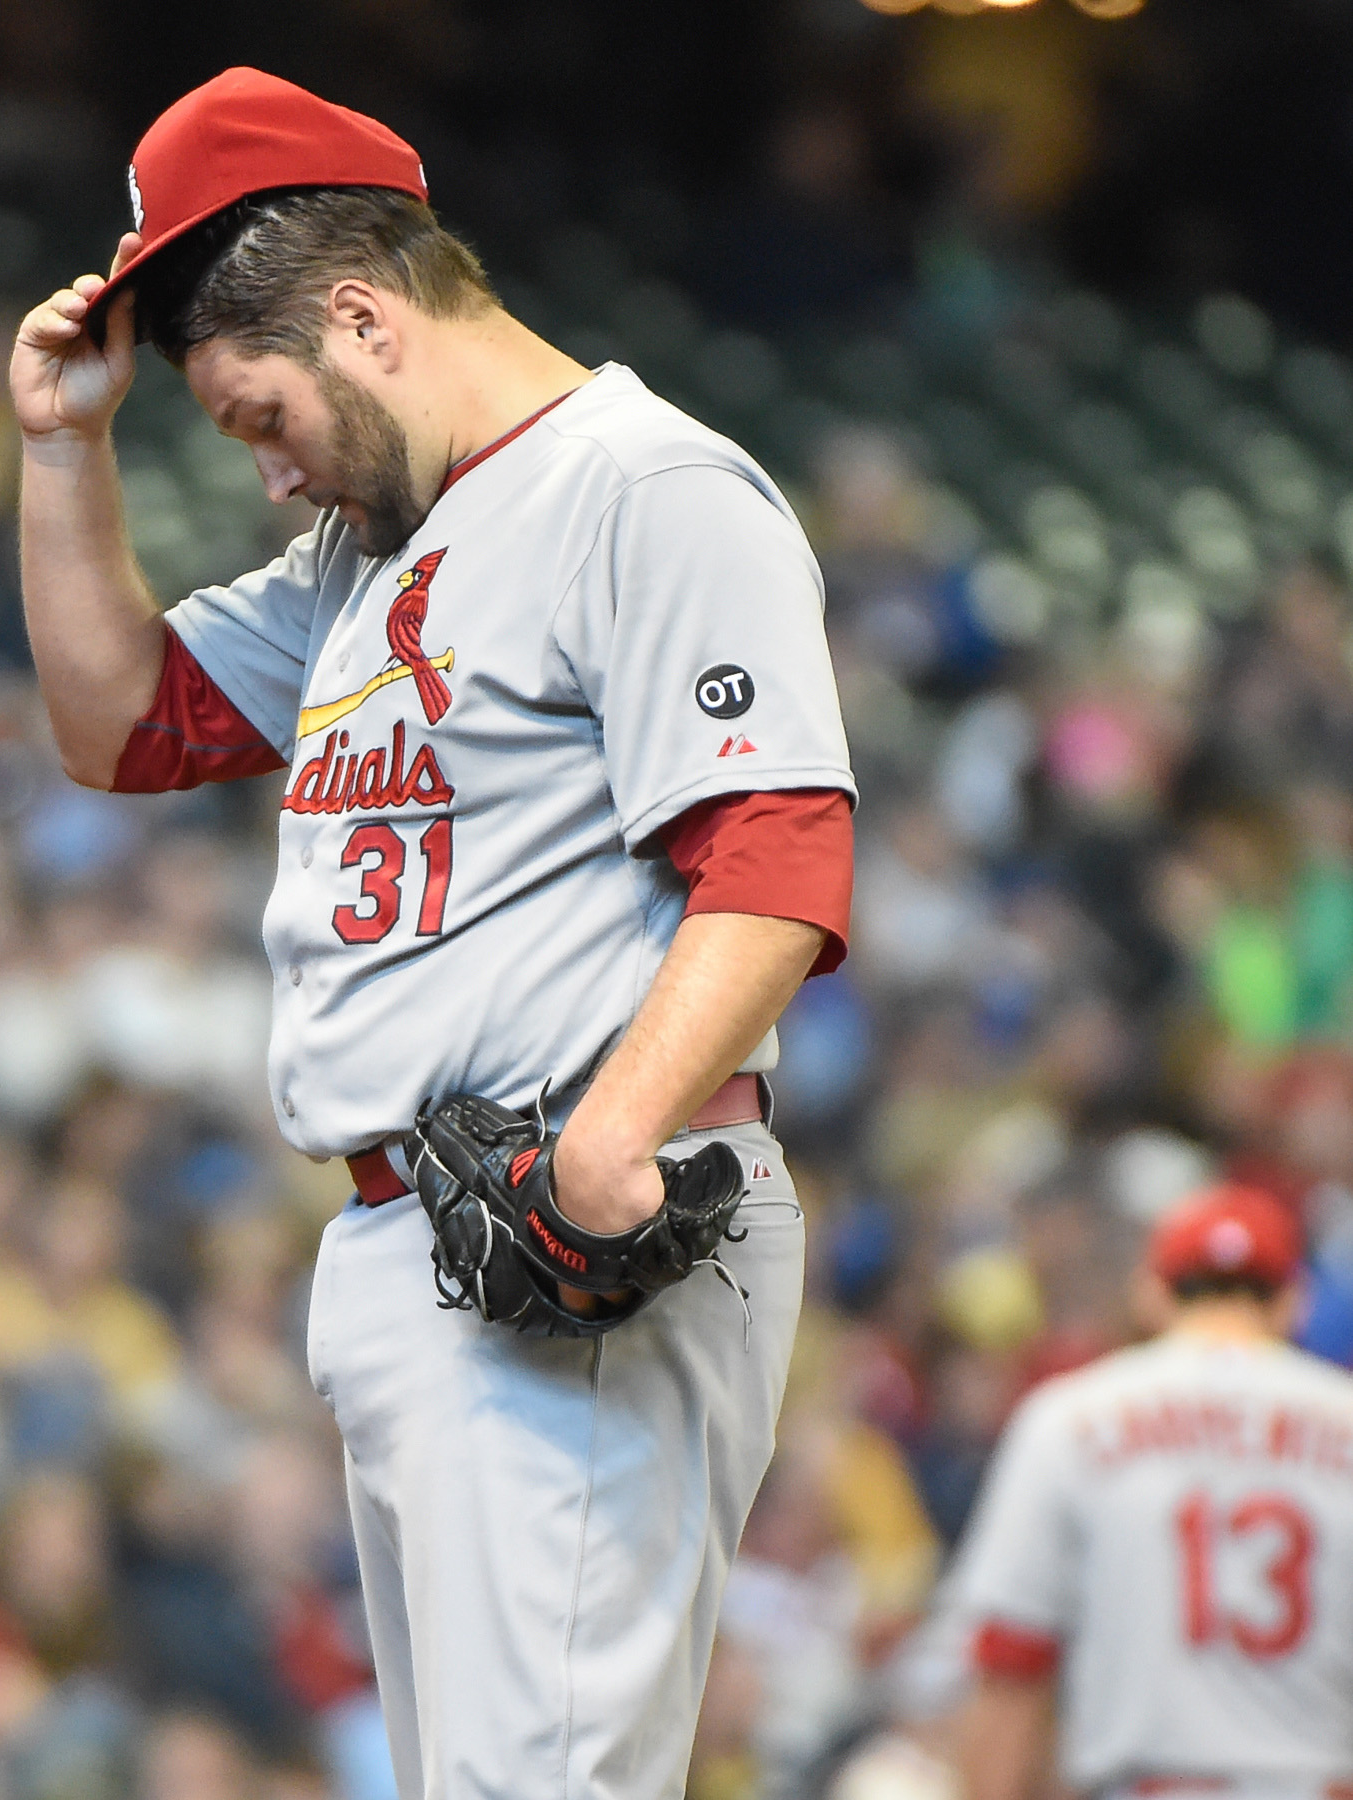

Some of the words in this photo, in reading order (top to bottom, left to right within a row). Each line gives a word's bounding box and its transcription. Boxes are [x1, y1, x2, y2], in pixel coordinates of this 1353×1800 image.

[699, 671, 745, 709] OT
[331, 814, 454, 945] 31
[1175, 1487, 1315, 1663] 13
